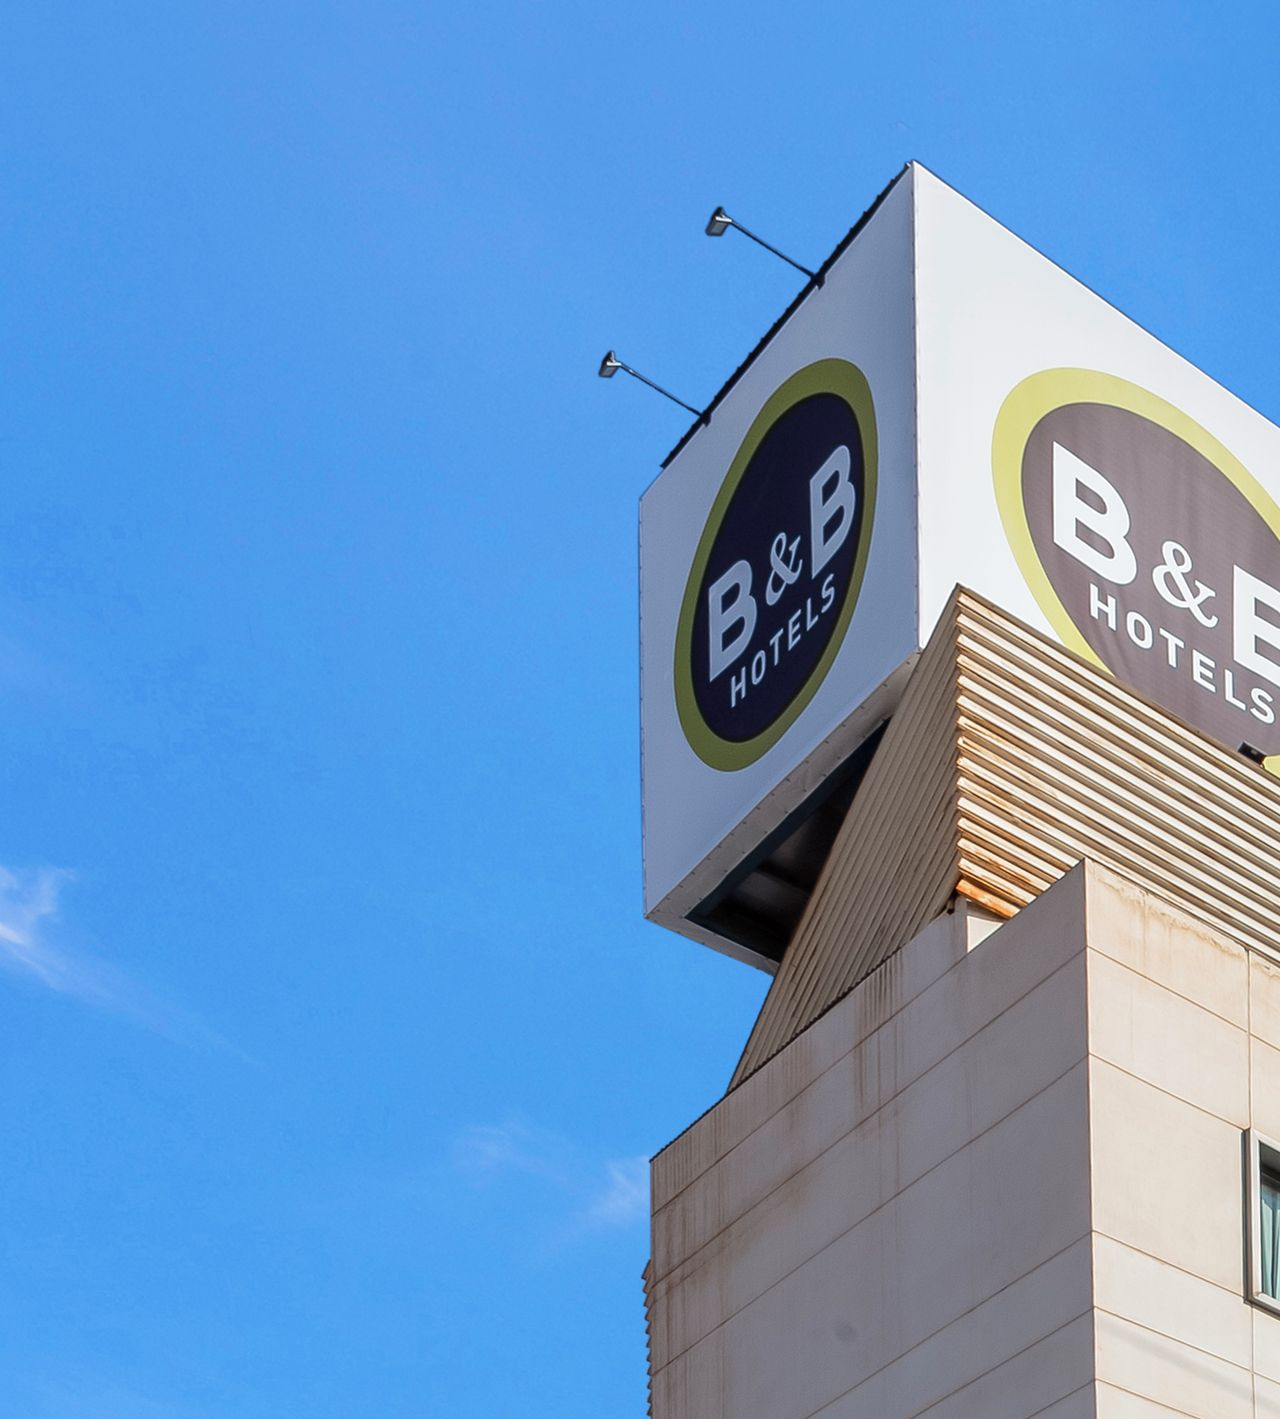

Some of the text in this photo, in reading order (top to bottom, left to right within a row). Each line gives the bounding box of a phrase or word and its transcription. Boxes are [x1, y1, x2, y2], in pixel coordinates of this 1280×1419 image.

[708, 445, 856, 682] B&B
[730, 573, 835, 708] HOTELS
[1090, 583, 1275, 724] HOTELS
